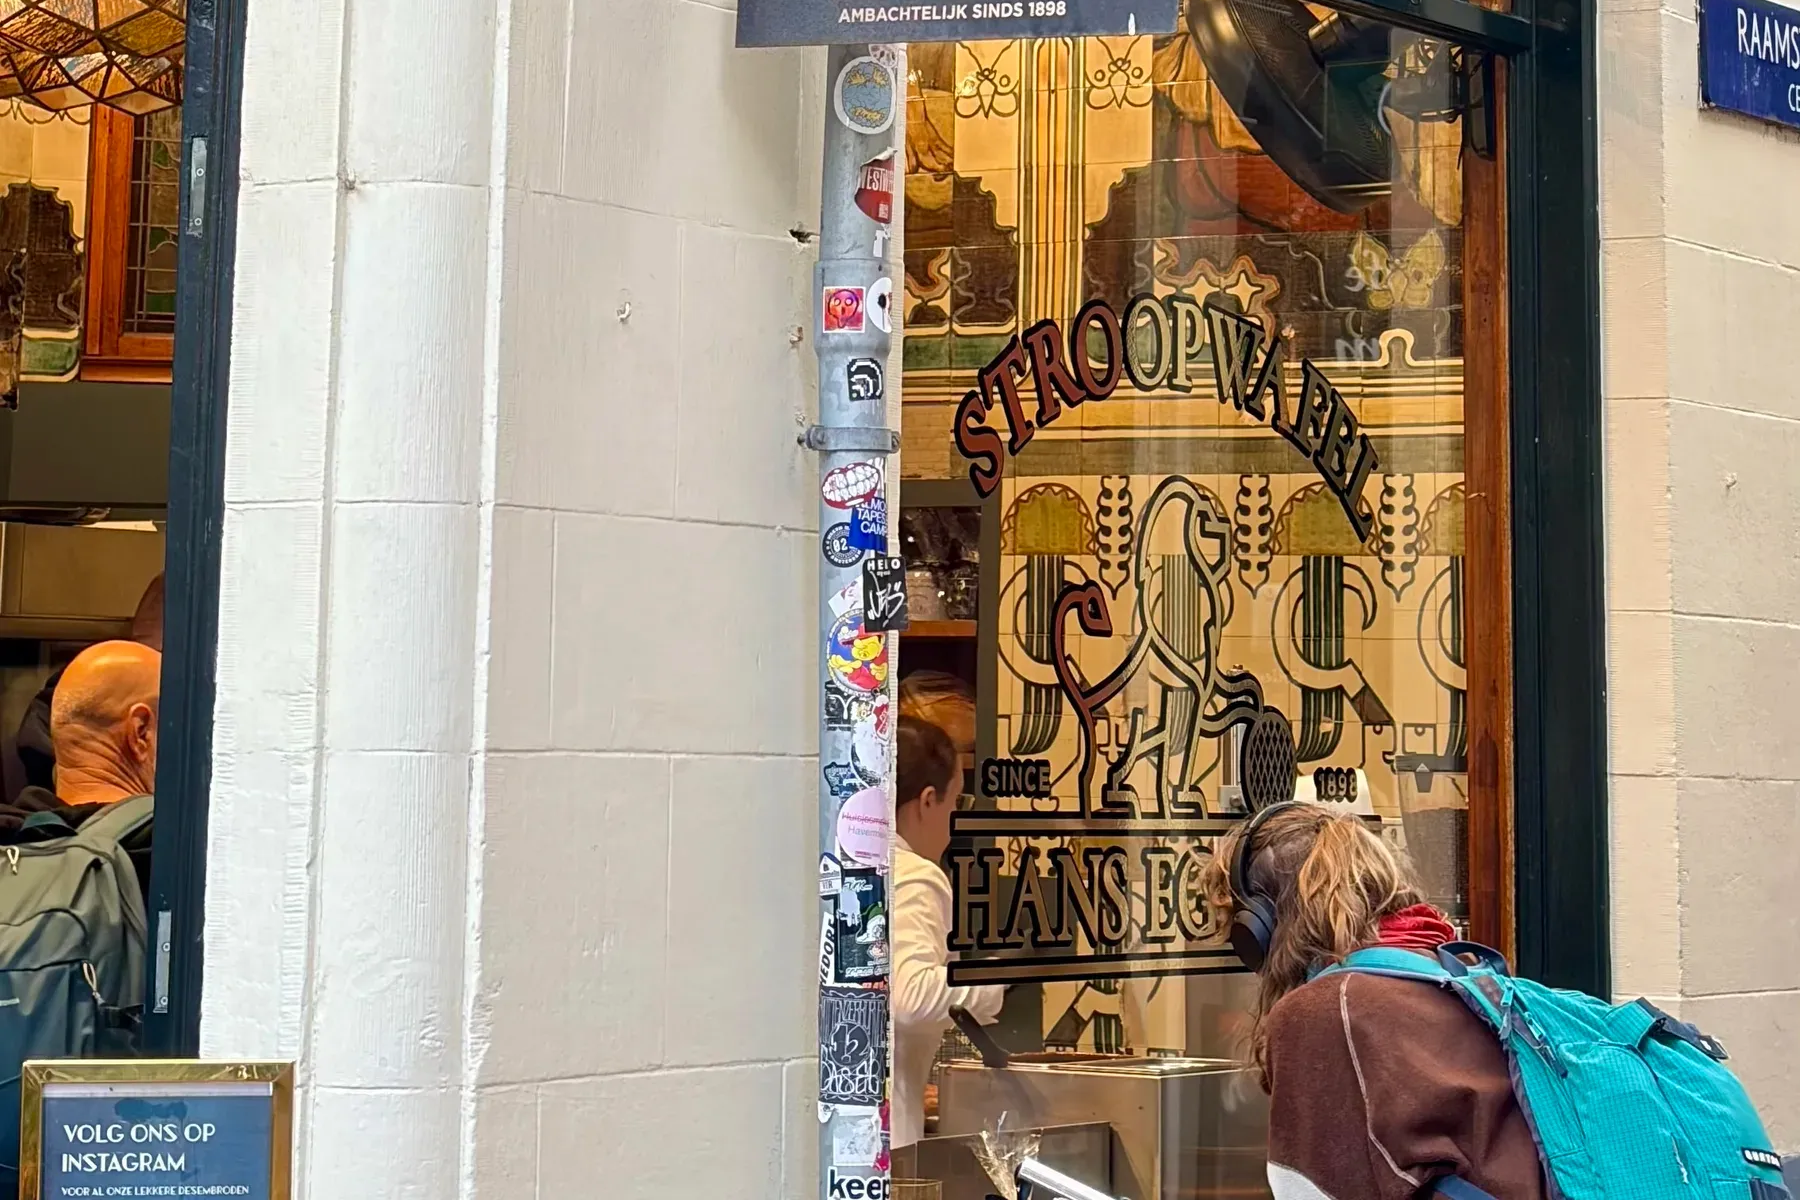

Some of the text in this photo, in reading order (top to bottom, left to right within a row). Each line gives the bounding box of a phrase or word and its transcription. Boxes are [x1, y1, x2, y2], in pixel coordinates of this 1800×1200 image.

[838, 0, 1067, 24] AMBACHTELIJK SINDS 1898
[1736, 7, 1800, 70] RAAMS
[953, 292, 1379, 544] STROOPWAFEL
[982, 759, 1359, 802] SINCE 1898
[947, 846, 1129, 952] HANS
[63, 1123, 216, 1144] VOLG ONS OP
[61, 1152, 186, 1173] INSTAGRAM
[61, 1185, 250, 1197] VOOR AL ONZE LEKKERE DESEMBRODEN
